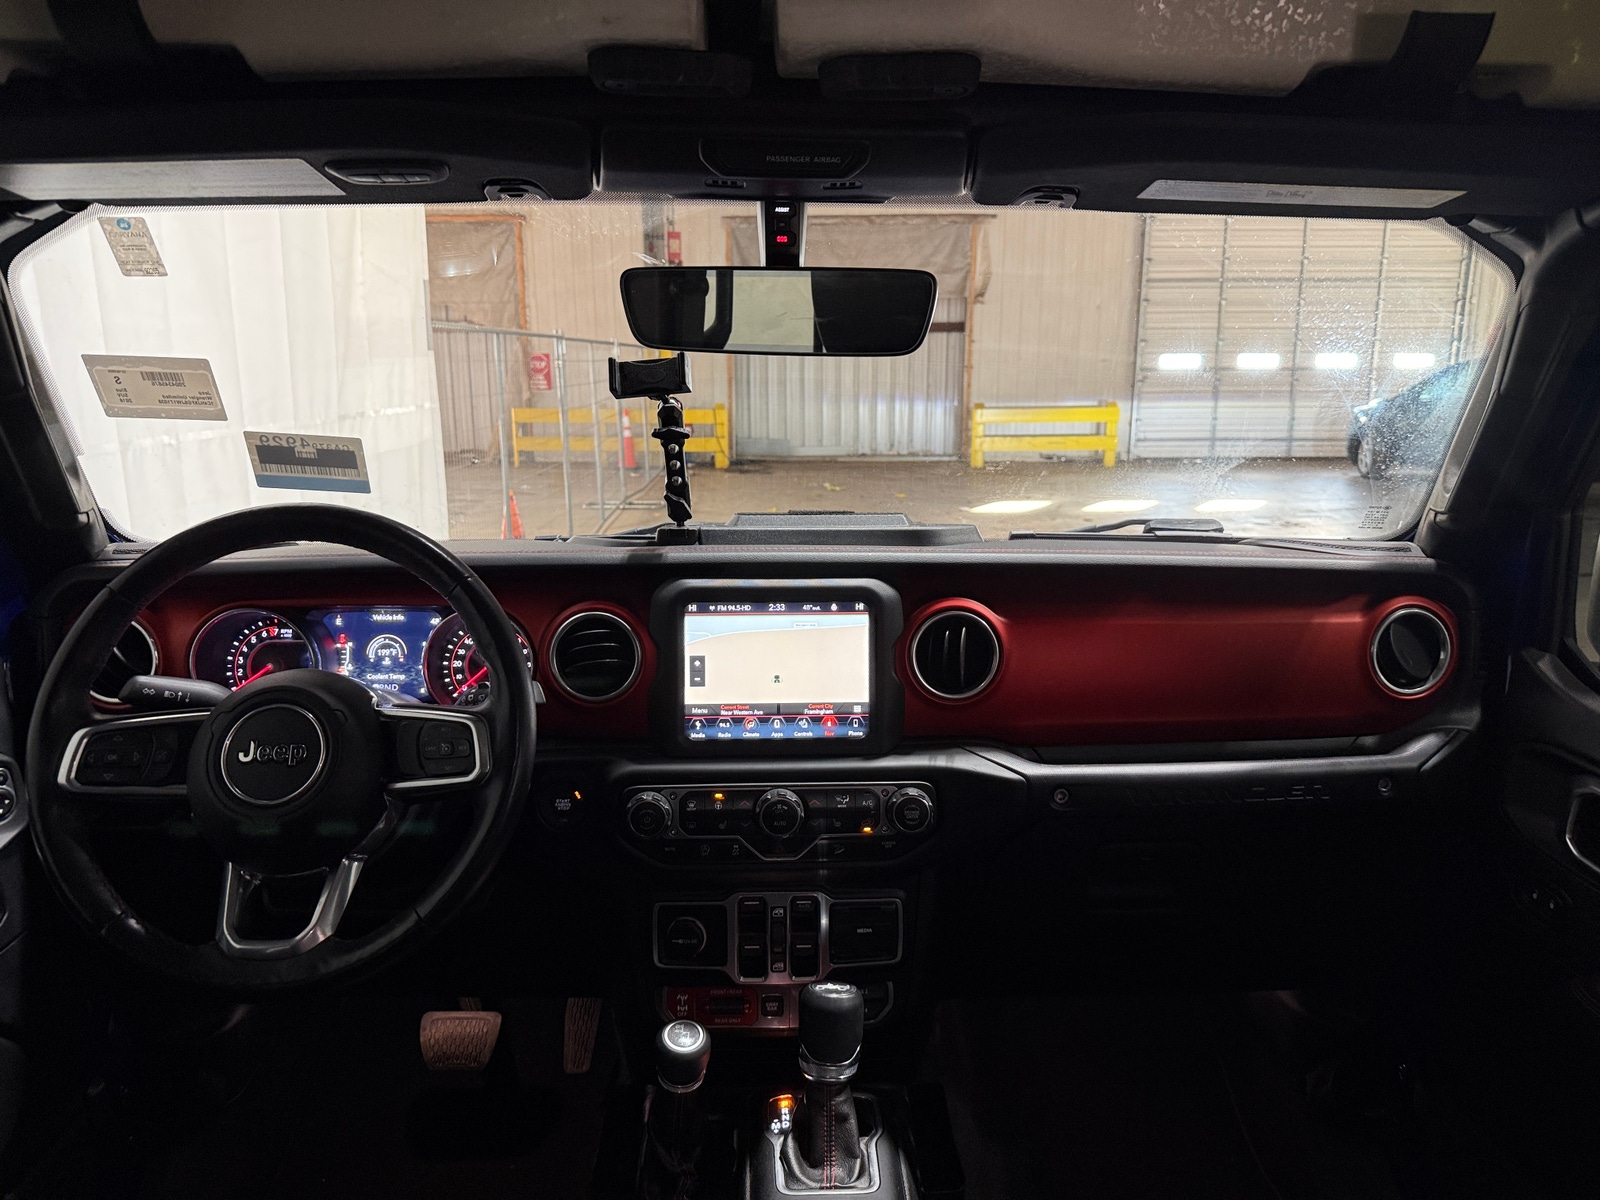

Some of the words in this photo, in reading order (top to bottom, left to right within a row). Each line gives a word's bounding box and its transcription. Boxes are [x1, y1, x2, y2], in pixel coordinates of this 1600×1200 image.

[766, 154, 811, 163] PASSENGER
[813, 156, 841, 164] AIRBAG
[688, 604, 697, 612] HI
[768, 603, 786, 611] 2:33
[855, 603, 864, 611] HI
[377, 648, 398, 656] 199°F
[237, 656, 244, 664] 3
[237, 668, 243, 676] 2
[238, 740, 307, 766] Jeep
[770, 1121, 781, 1130] M
